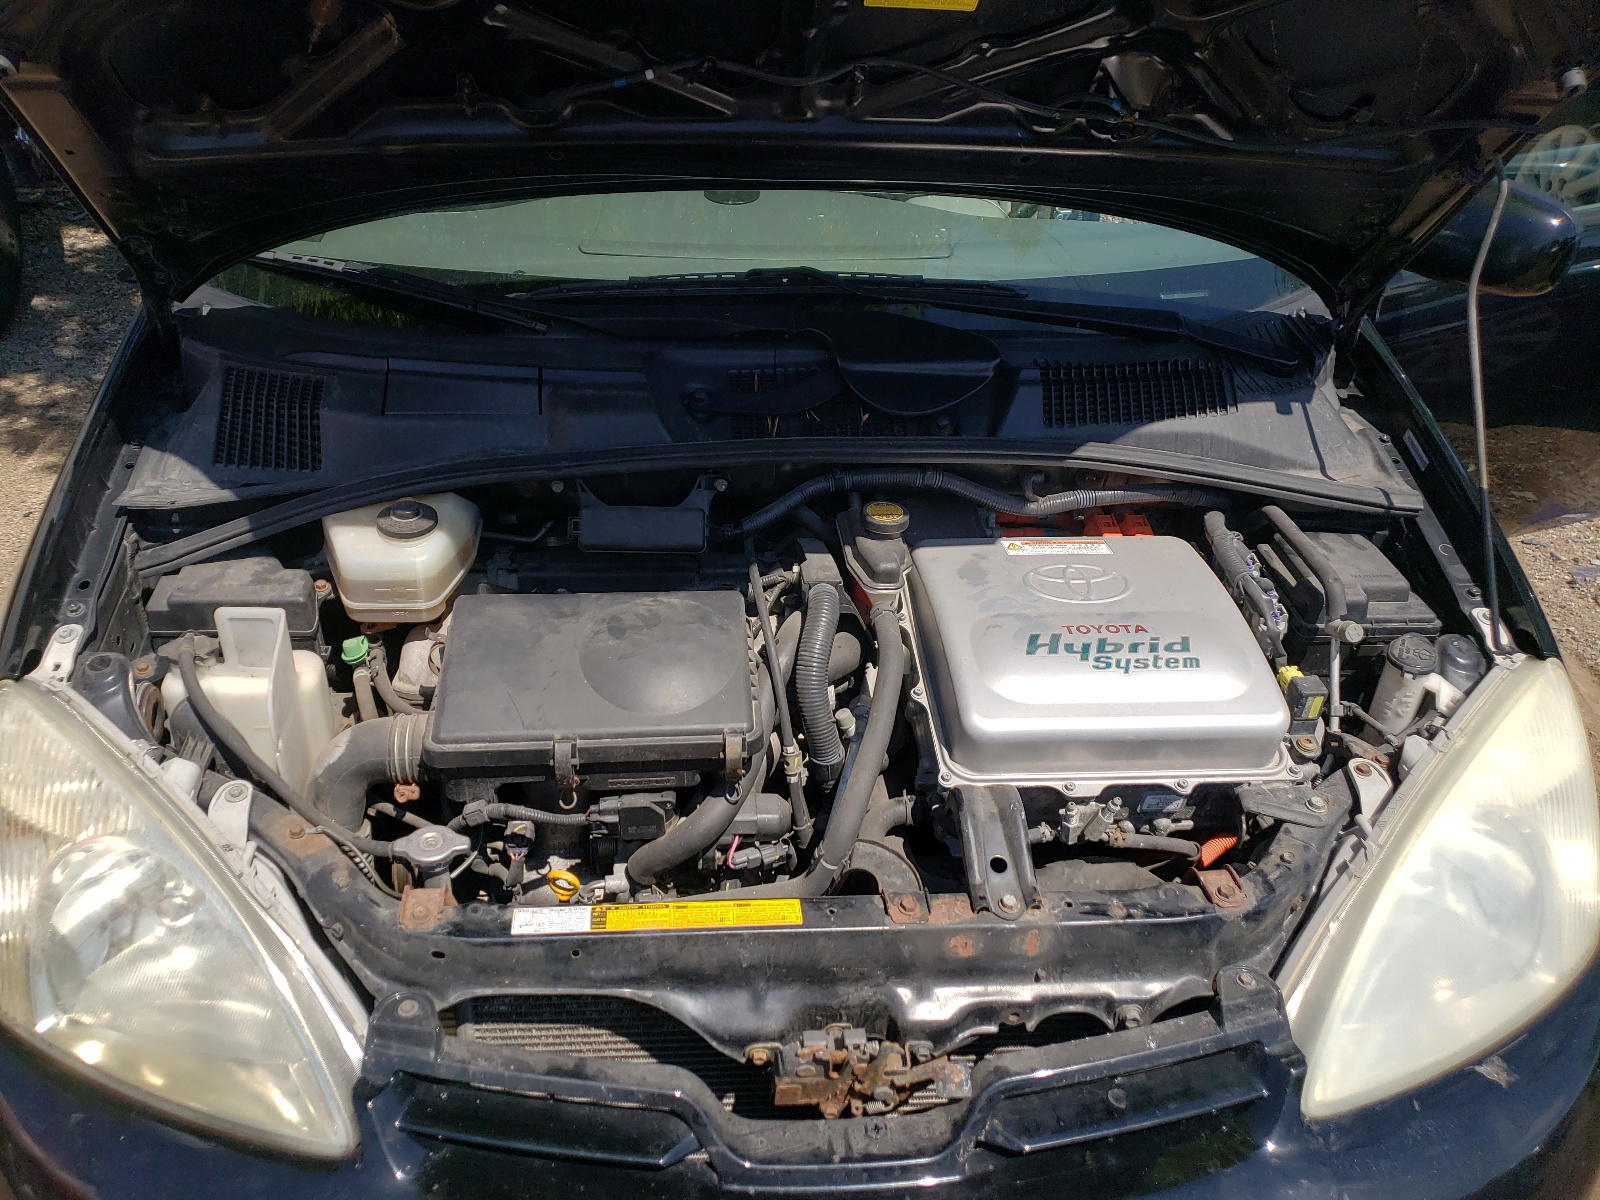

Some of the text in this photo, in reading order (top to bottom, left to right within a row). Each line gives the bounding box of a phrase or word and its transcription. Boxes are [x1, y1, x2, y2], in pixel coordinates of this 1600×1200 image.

[1062, 624, 1149, 634] TOYOTA
[1026, 633, 1191, 661] Hybrid
[1092, 655, 1200, 674] System
